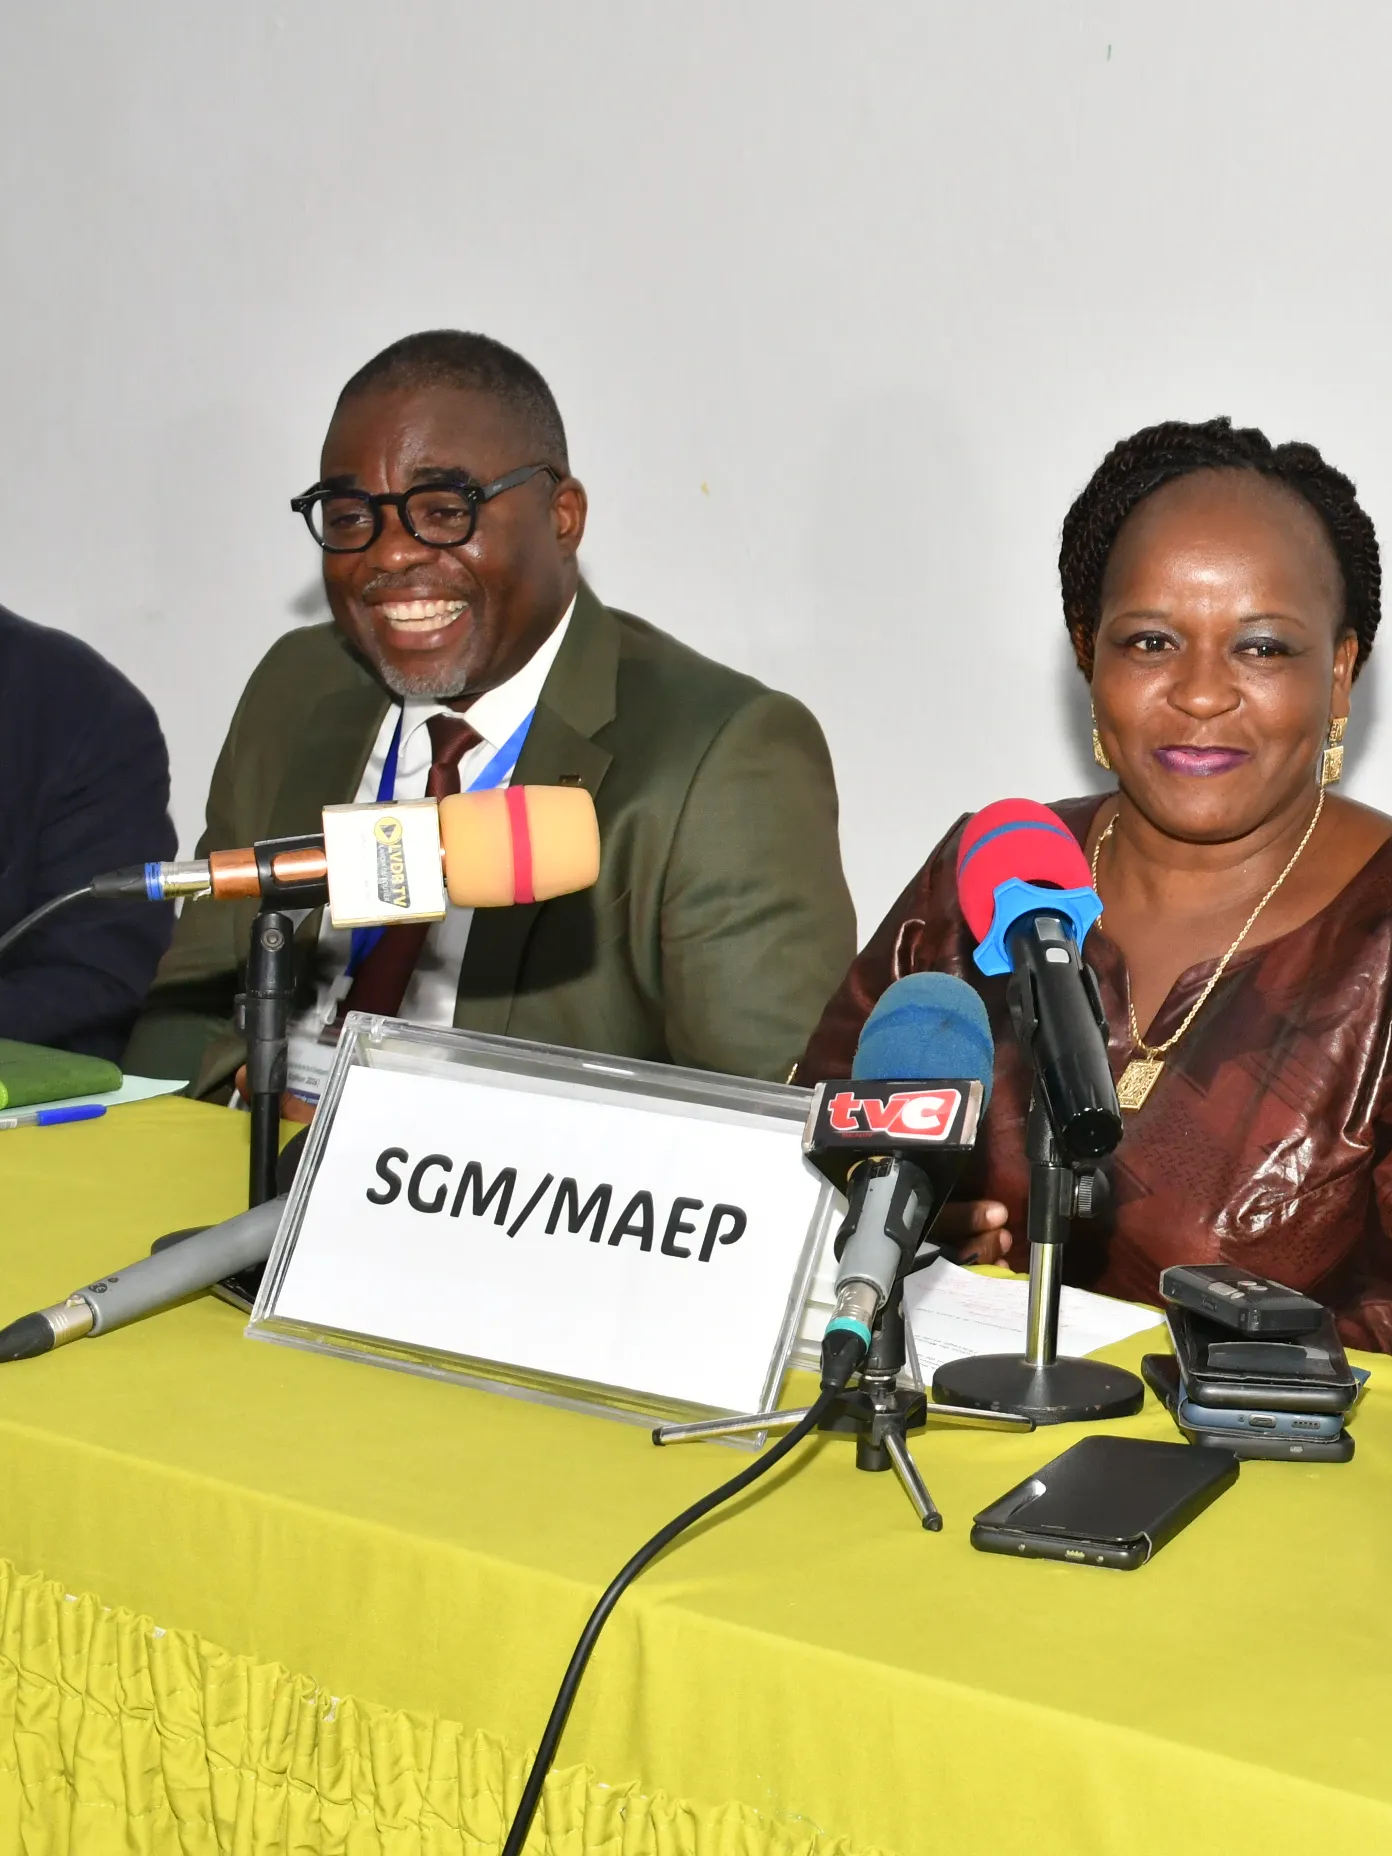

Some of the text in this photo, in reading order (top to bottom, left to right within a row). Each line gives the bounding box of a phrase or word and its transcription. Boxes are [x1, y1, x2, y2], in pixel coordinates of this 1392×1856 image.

[388, 844, 407, 907] LVDR TV
[366, 1147, 747, 1263] SGM/MAEP
